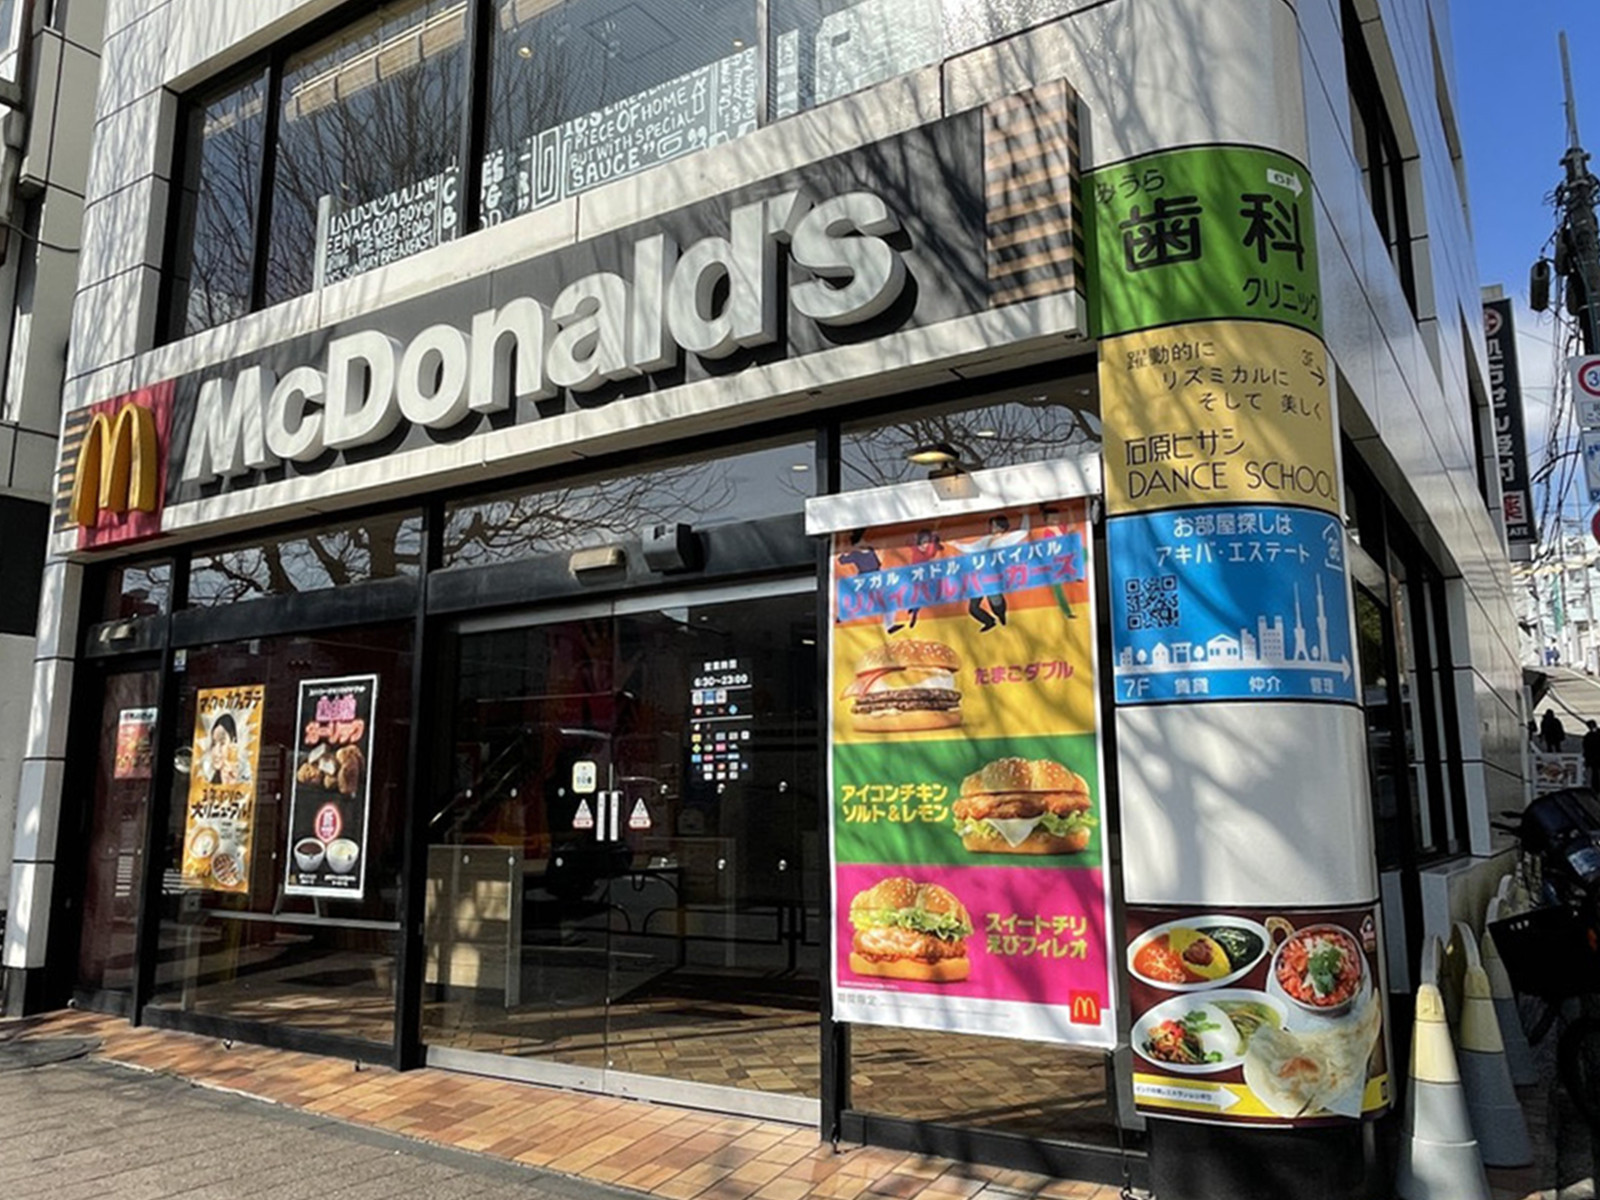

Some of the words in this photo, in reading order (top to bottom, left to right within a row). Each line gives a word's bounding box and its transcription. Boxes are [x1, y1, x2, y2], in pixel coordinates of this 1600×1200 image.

[641, 87, 688, 121] HOME
[1095, 169, 1165, 204] みうら
[185, 189, 905, 480] McDonald's
[1162, 366, 1290, 390] リズミカルに
[1200, 391, 1263, 411] そして
[1124, 428, 1245, 466] 石原ヒサシ
[1129, 461, 1229, 499] DANCE
[1173, 513, 1293, 537] お部屋探しは
[853, 572, 900, 592] アガル
[911, 560, 961, 582] オドル
[972, 542, 1063, 568] リバイバル
[1124, 678, 1150, 697] 7F
[1249, 676, 1282, 693] 仲介
[841, 784, 949, 803] アイコンチキン
[985, 913, 1088, 936] スイートチリ
